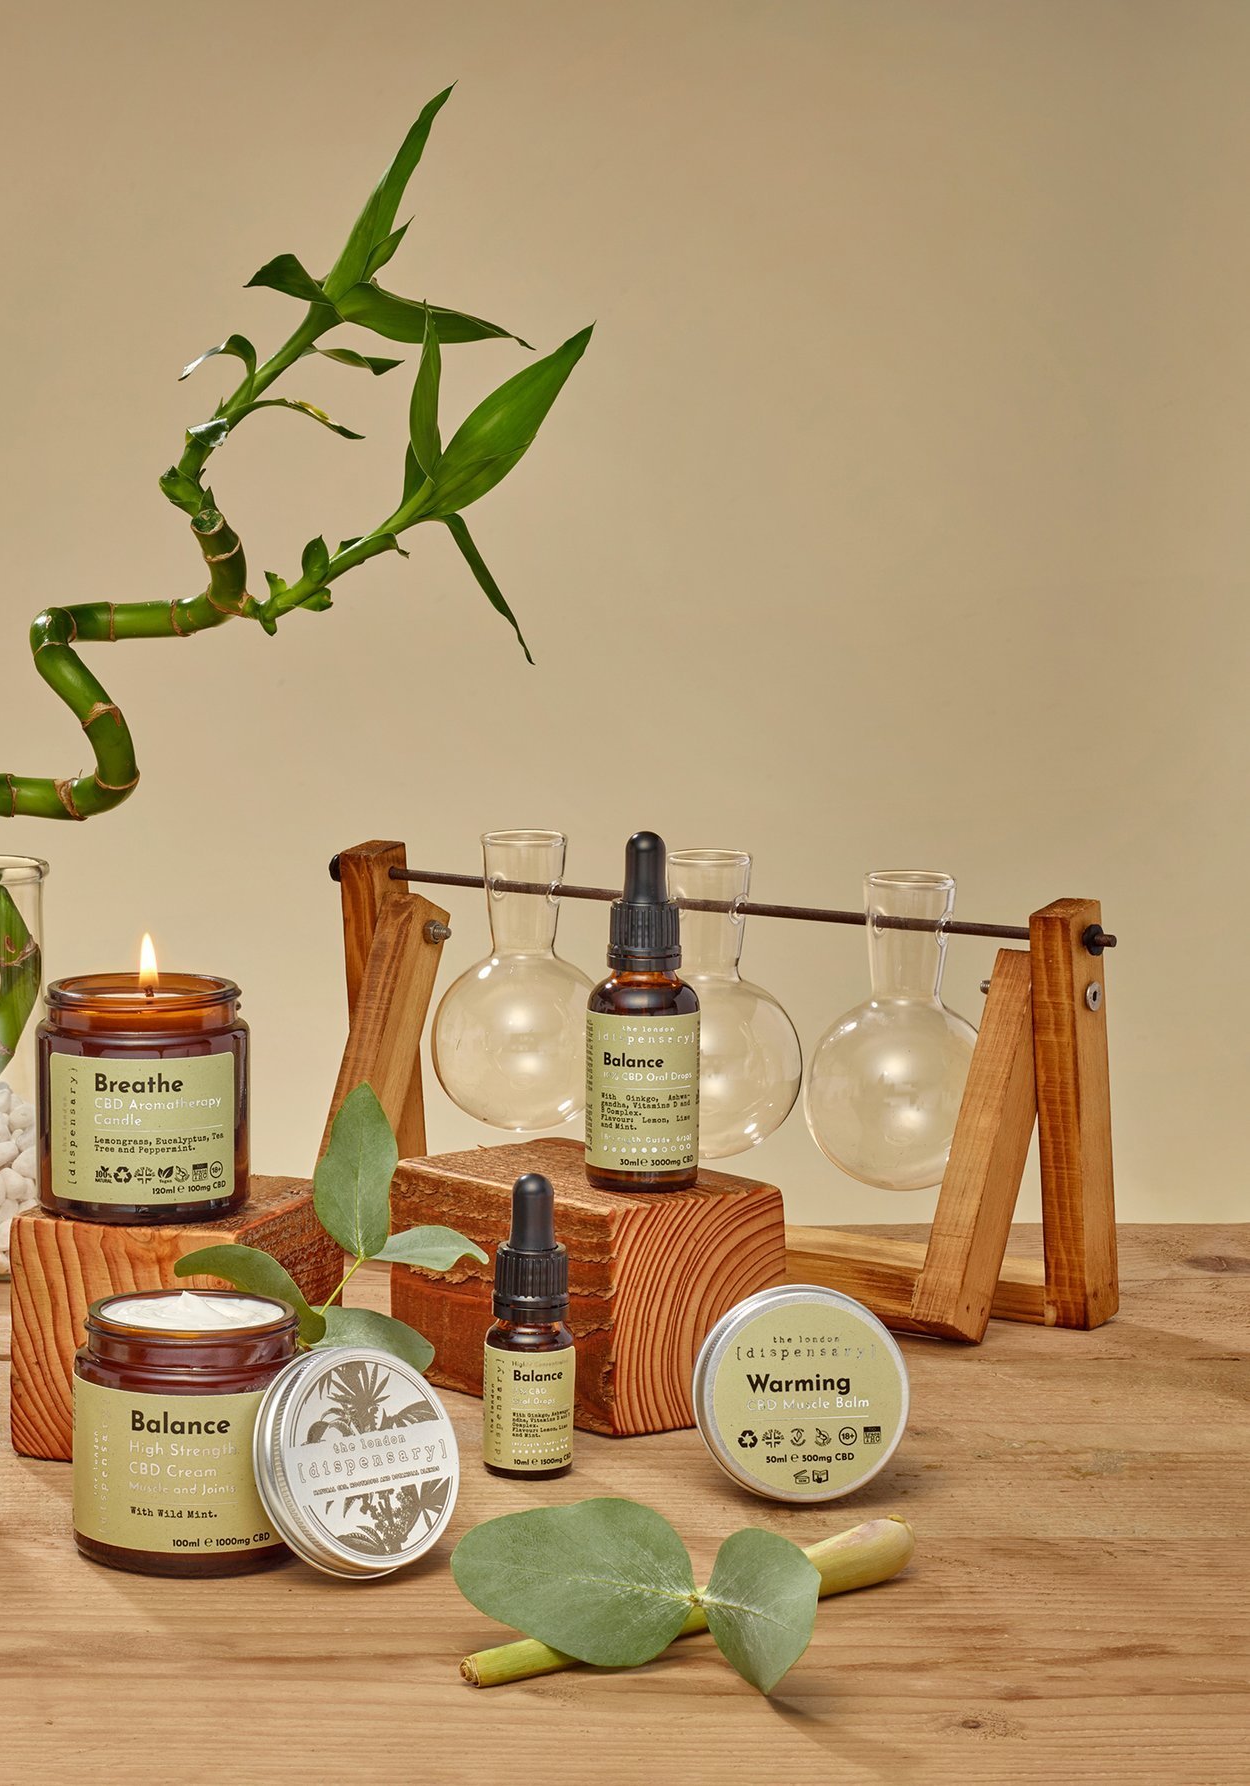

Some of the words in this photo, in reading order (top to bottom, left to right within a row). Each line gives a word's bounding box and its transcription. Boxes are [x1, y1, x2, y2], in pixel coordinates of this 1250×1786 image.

[604, 1052, 664, 1068] Balance
[95, 1073, 184, 1093] Breathe
[622, 1073, 642, 1081] CBD
[647, 1073, 667, 1082] Oral
[671, 1072, 692, 1080] Drops
[94, 1097, 123, 1110] CBD
[129, 1097, 221, 1110] Aromatherapy
[601, 1092, 617, 1100] With
[626, 1095, 659, 1103] Ginkgo,
[668, 1093, 690, 1101] Ashwa-
[601, 1101, 629, 1109] gandha,
[601, 1114, 634, 1123] Flavour:
[607, 1108, 642, 1117] Complex.
[68, 1067, 78, 1185] [dispensary]
[94, 1114, 142, 1126] Candle
[94, 1136, 152, 1146] Lemongrass,
[155, 1135, 209, 1145] Eucalyptus,
[138, 1145, 195, 1154] Peppermint.
[620, 1158, 639, 1166] 30ml
[650, 1159, 681, 1167] 3000mg
[683, 1155, 693, 1163] CBD
[188, 1185, 211, 1194] 100mg
[213, 1180, 226, 1188] CBD
[513, 1370, 563, 1382] Balance
[746, 1374, 850, 1395] Warming
[747, 1399, 777, 1411] CBD
[783, 1399, 829, 1410] Muscle
[836, 1396, 869, 1408] Balm
[131, 1410, 230, 1434] Balance
[129, 1440, 163, 1457] High
[170, 1443, 237, 1459] Strength
[333, 1443, 356, 1454] the
[360, 1434, 406, 1450] london
[298, 1439, 447, 1484] [dispensary]
[766, 1455, 787, 1463] 50ml
[802, 1454, 832, 1464] 500mg
[835, 1453, 854, 1461] CBD
[129, 1462, 160, 1476] CBD
[167, 1465, 216, 1478] Cream
[129, 1482, 169, 1494] Muscle
[174, 1485, 197, 1494] and
[202, 1483, 236, 1495] Joints
[130, 1506, 153, 1517] With
[157, 1509, 183, 1519] Wild
[187, 1510, 218, 1519] Mint.
[172, 1539, 200, 1547] 100ml
[215, 1537, 250, 1546] 1000mg
[253, 1532, 270, 1542] CBD
